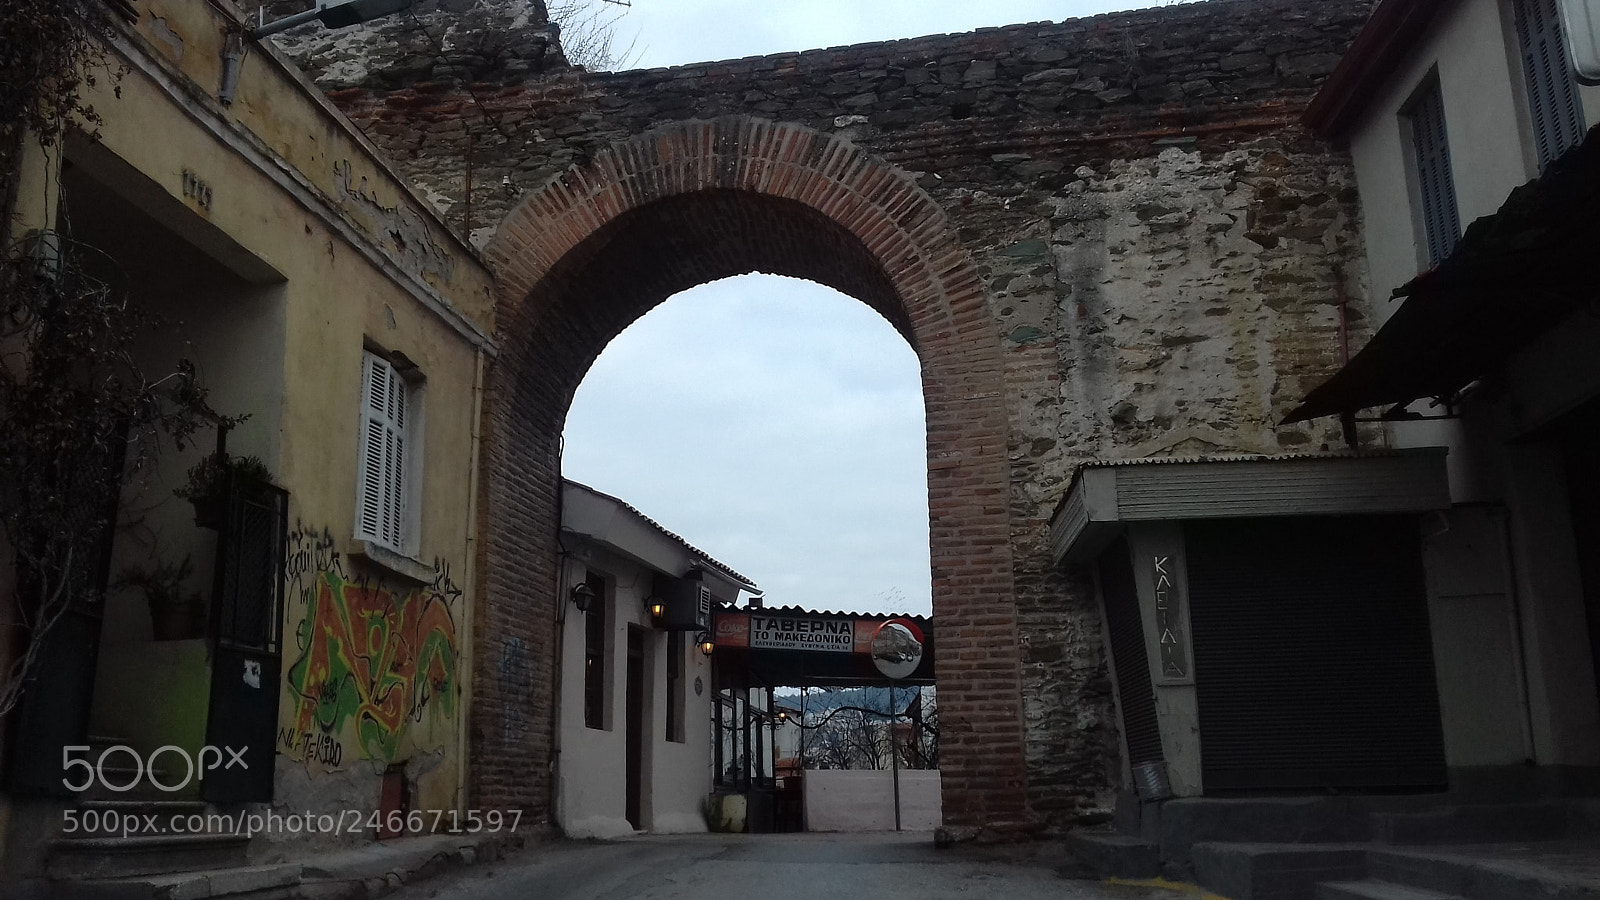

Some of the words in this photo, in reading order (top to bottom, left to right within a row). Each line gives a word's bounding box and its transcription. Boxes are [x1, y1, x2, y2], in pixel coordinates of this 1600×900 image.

[752, 616, 851, 635] ΤΑΒΕΡΝΑ
[754, 630, 769, 640] ΤΟ
[775, 631, 851, 645] ΜΑΚΕΔΟΝΙΚΟ
